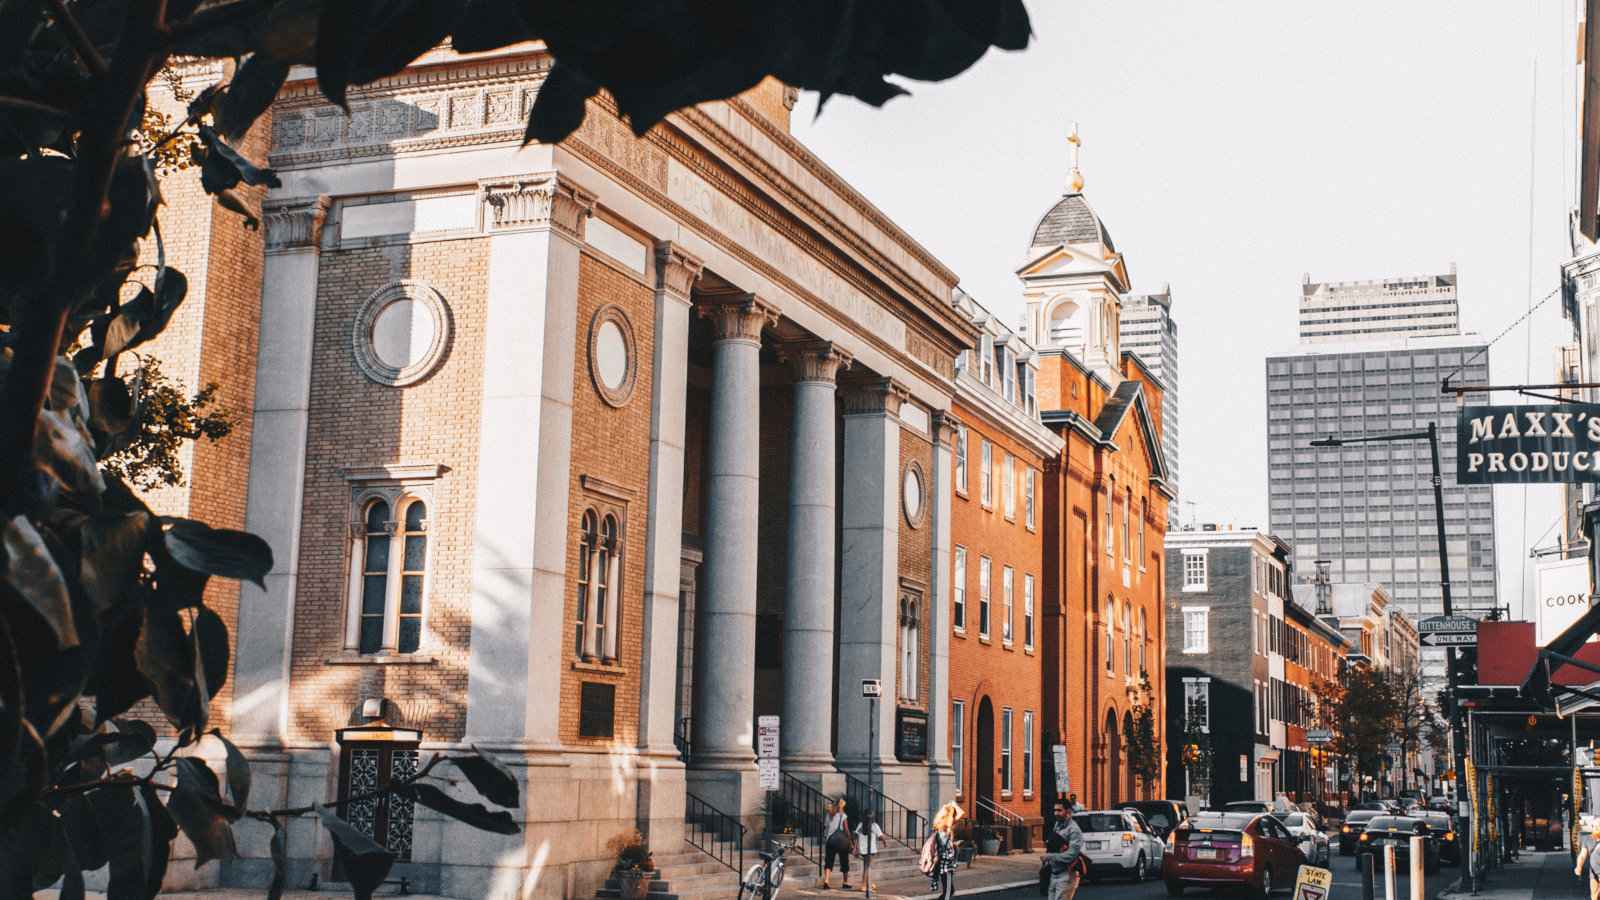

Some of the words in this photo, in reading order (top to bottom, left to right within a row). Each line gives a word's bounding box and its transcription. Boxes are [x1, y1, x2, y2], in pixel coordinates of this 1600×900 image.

[1469, 412, 1600, 444] MAXX'S
[1546, 593, 1585, 608] COOK
[1420, 621, 1471, 631] RITTENHOUSE
[1457, 634, 1474, 642] WAY
[1306, 869, 1327, 879] STATE
